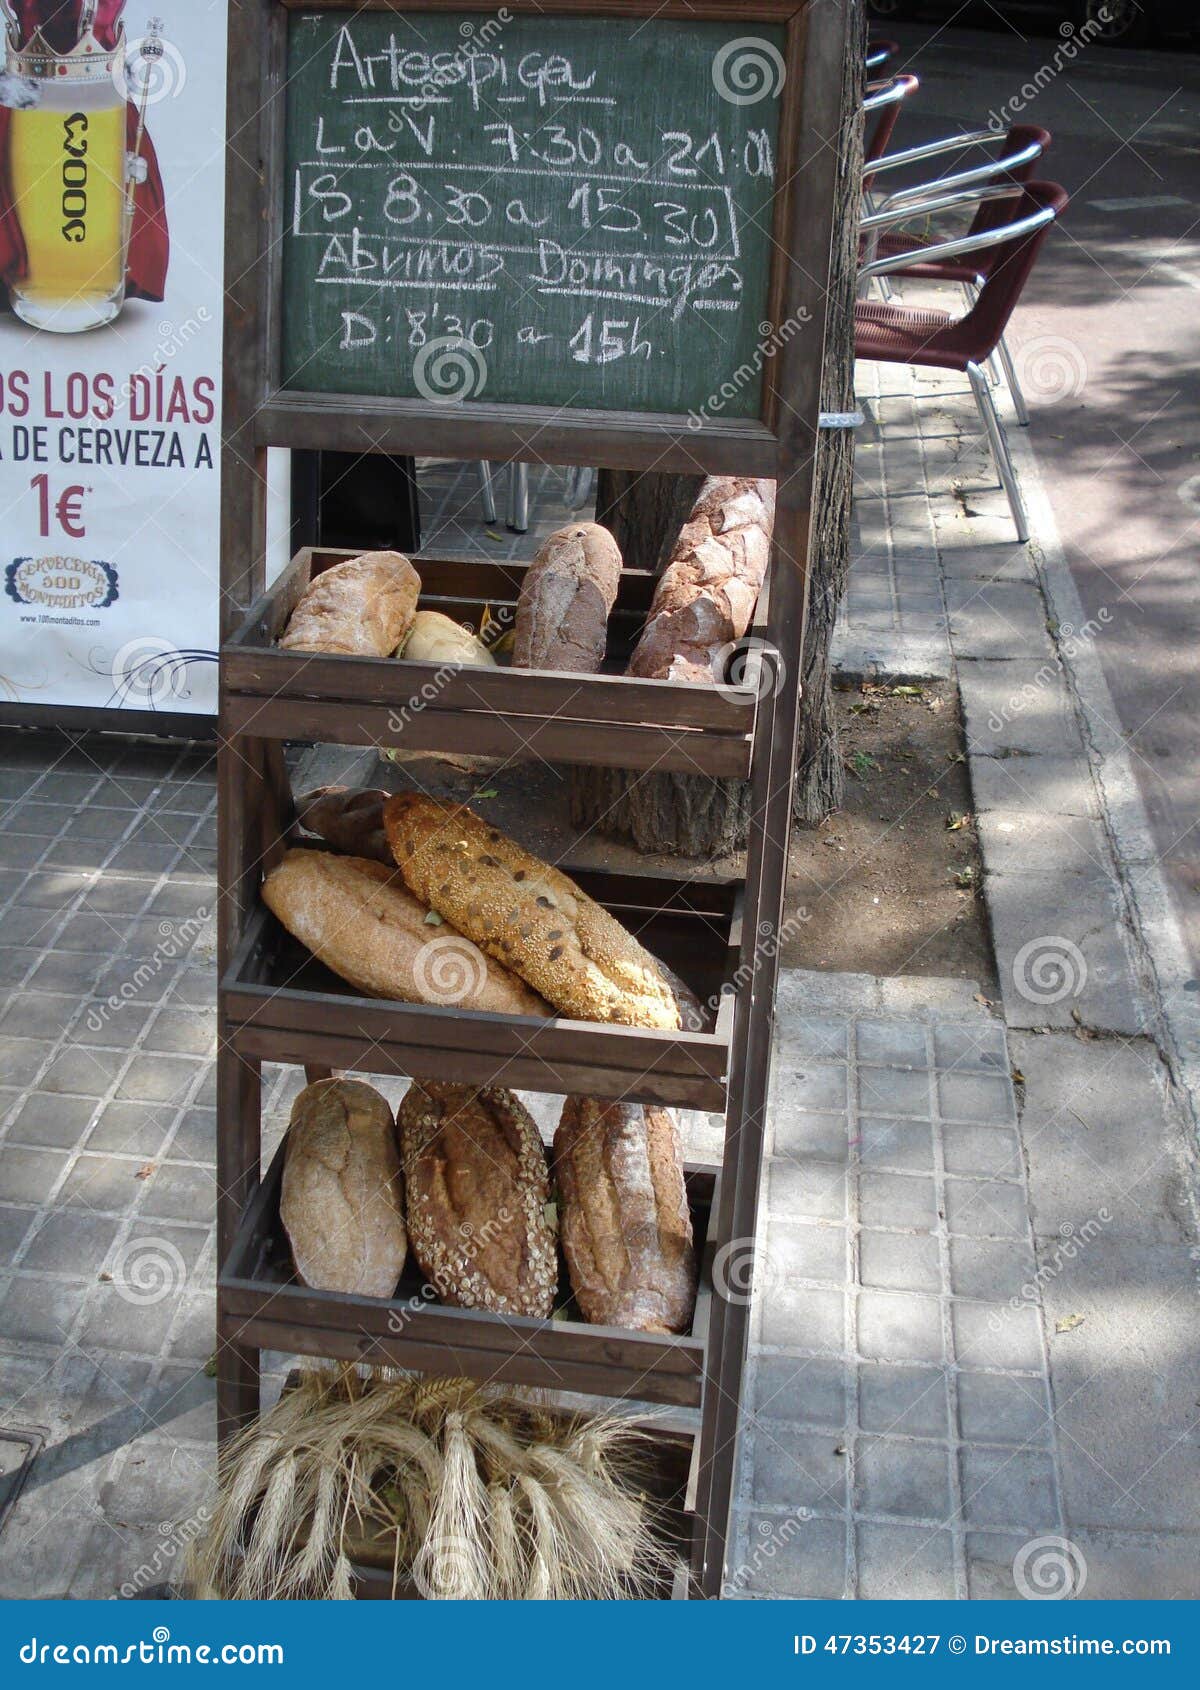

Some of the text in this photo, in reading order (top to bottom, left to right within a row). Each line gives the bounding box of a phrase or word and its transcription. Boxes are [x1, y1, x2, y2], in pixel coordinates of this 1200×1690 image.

[316, 117, 346, 153] L
[355, 126, 397, 151] a
[614, 143, 649, 170] a
[506, 199, 550, 228] a
[318, 227, 504, 282] Abrimos
[516, 326, 552, 345] a
[0, 363, 215, 424] S LOS DÍAS
[13, 425, 214, 470] DE CERVEZA A
